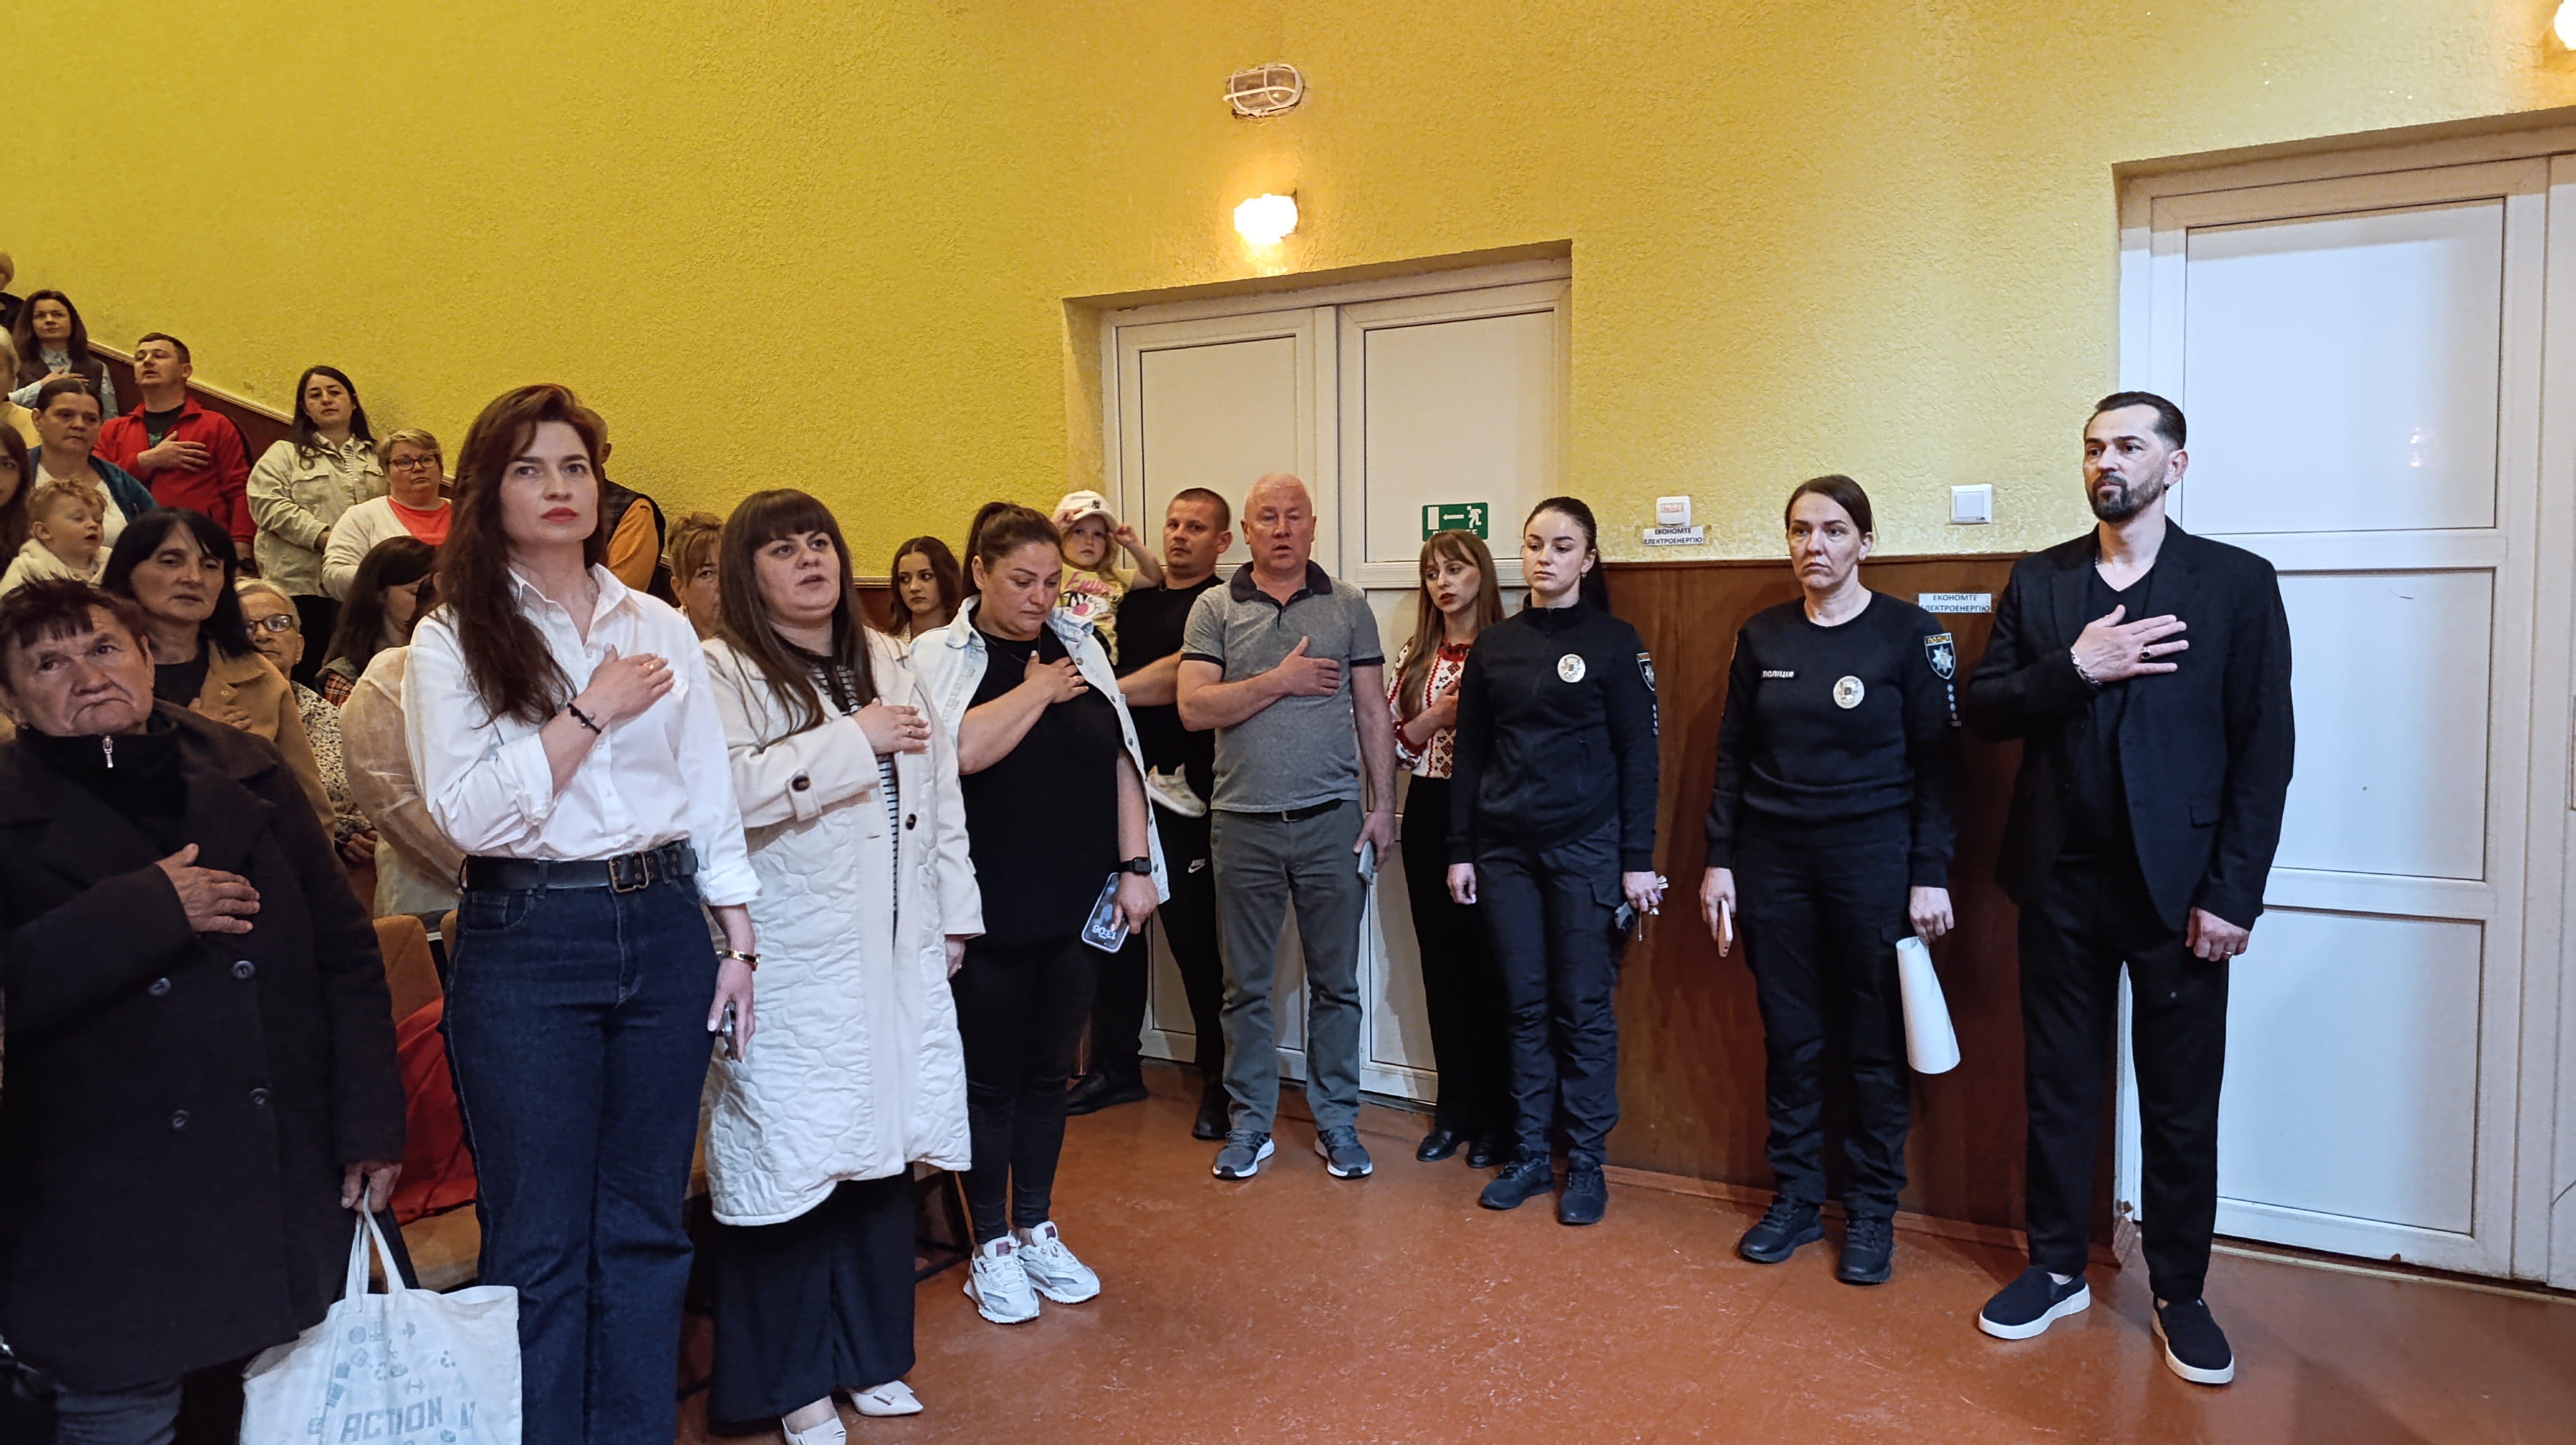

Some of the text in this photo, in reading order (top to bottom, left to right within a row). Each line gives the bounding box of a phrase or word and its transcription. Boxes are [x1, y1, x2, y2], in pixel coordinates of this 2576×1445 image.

[1762, 670, 1794, 678] ПОЛІЦІЯ
[1092, 925, 1116, 940] 13:06
[339, 1395, 442, 1444] ACTION
